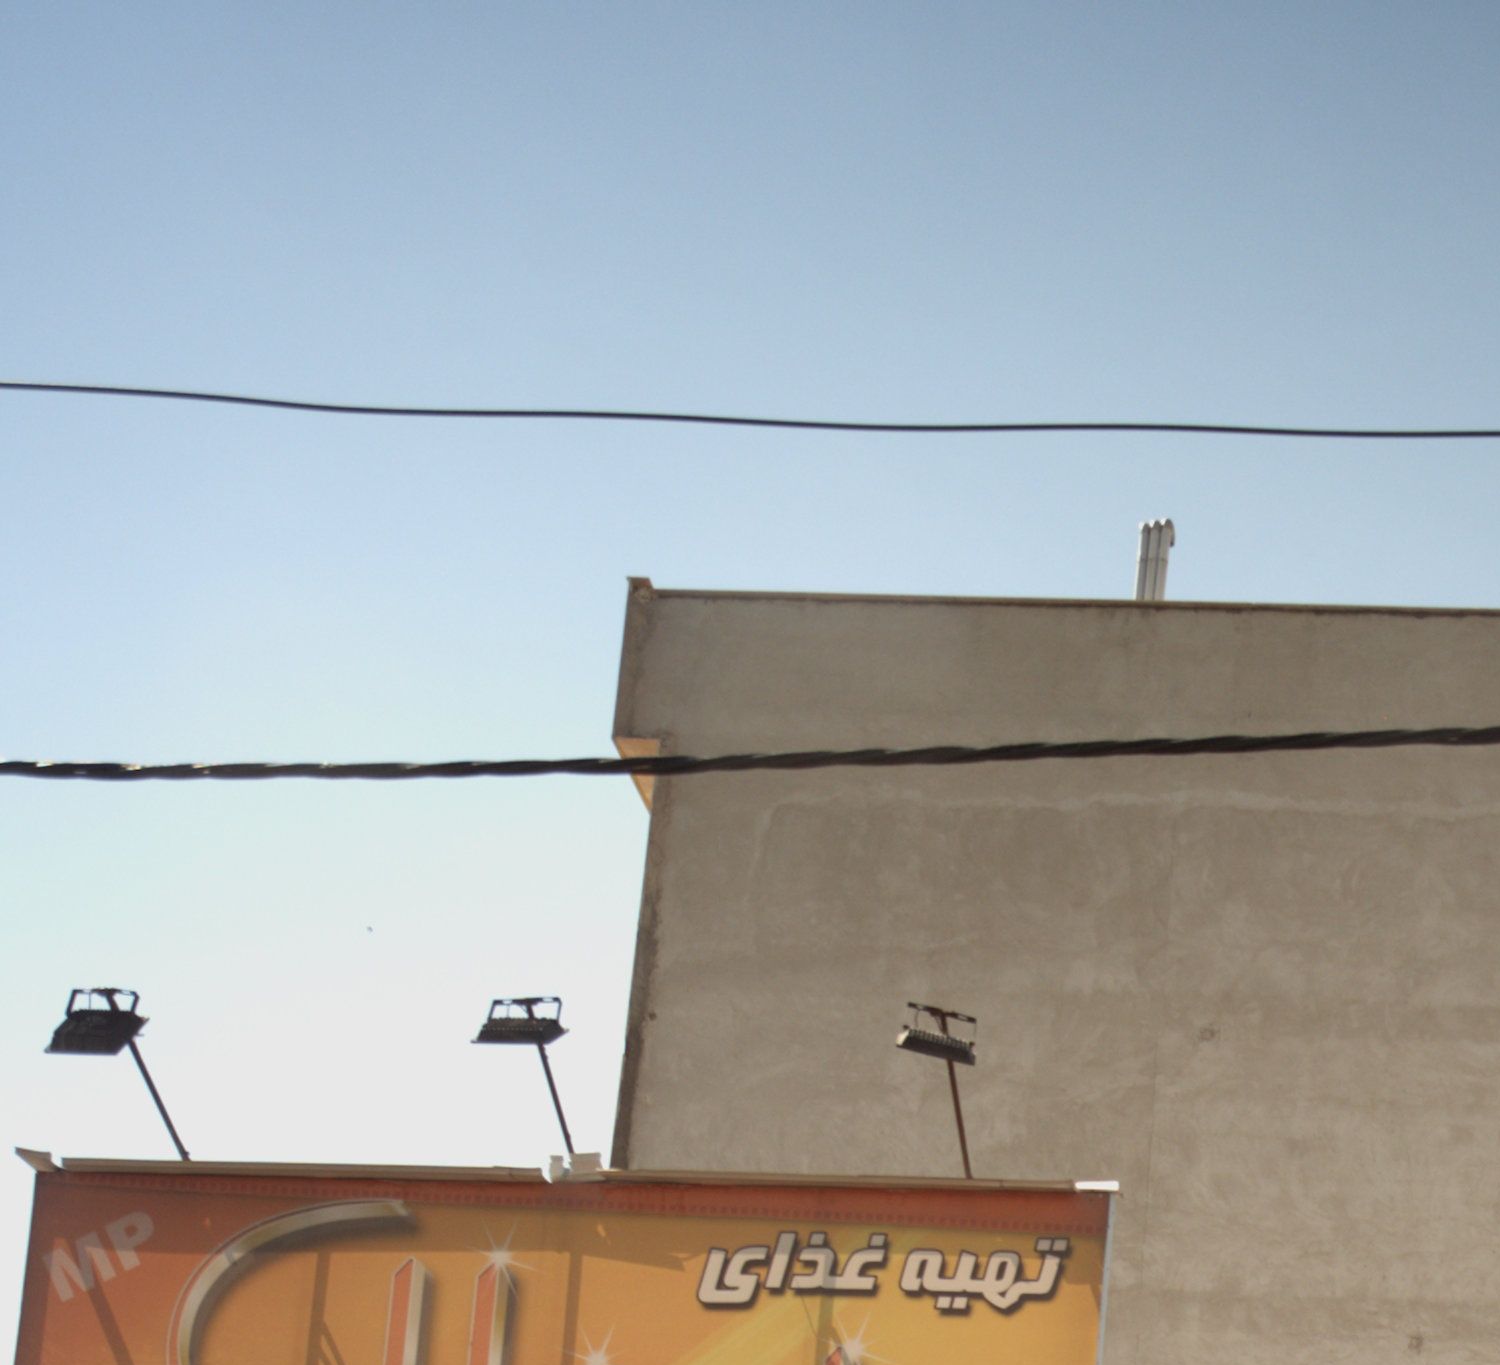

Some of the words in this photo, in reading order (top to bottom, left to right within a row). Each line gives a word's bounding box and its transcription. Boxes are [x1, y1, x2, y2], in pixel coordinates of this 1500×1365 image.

[42, 1211, 154, 1303] MP
[698, 1231, 886, 1305] غذای
[899, 1237, 1070, 1311] تهیه
